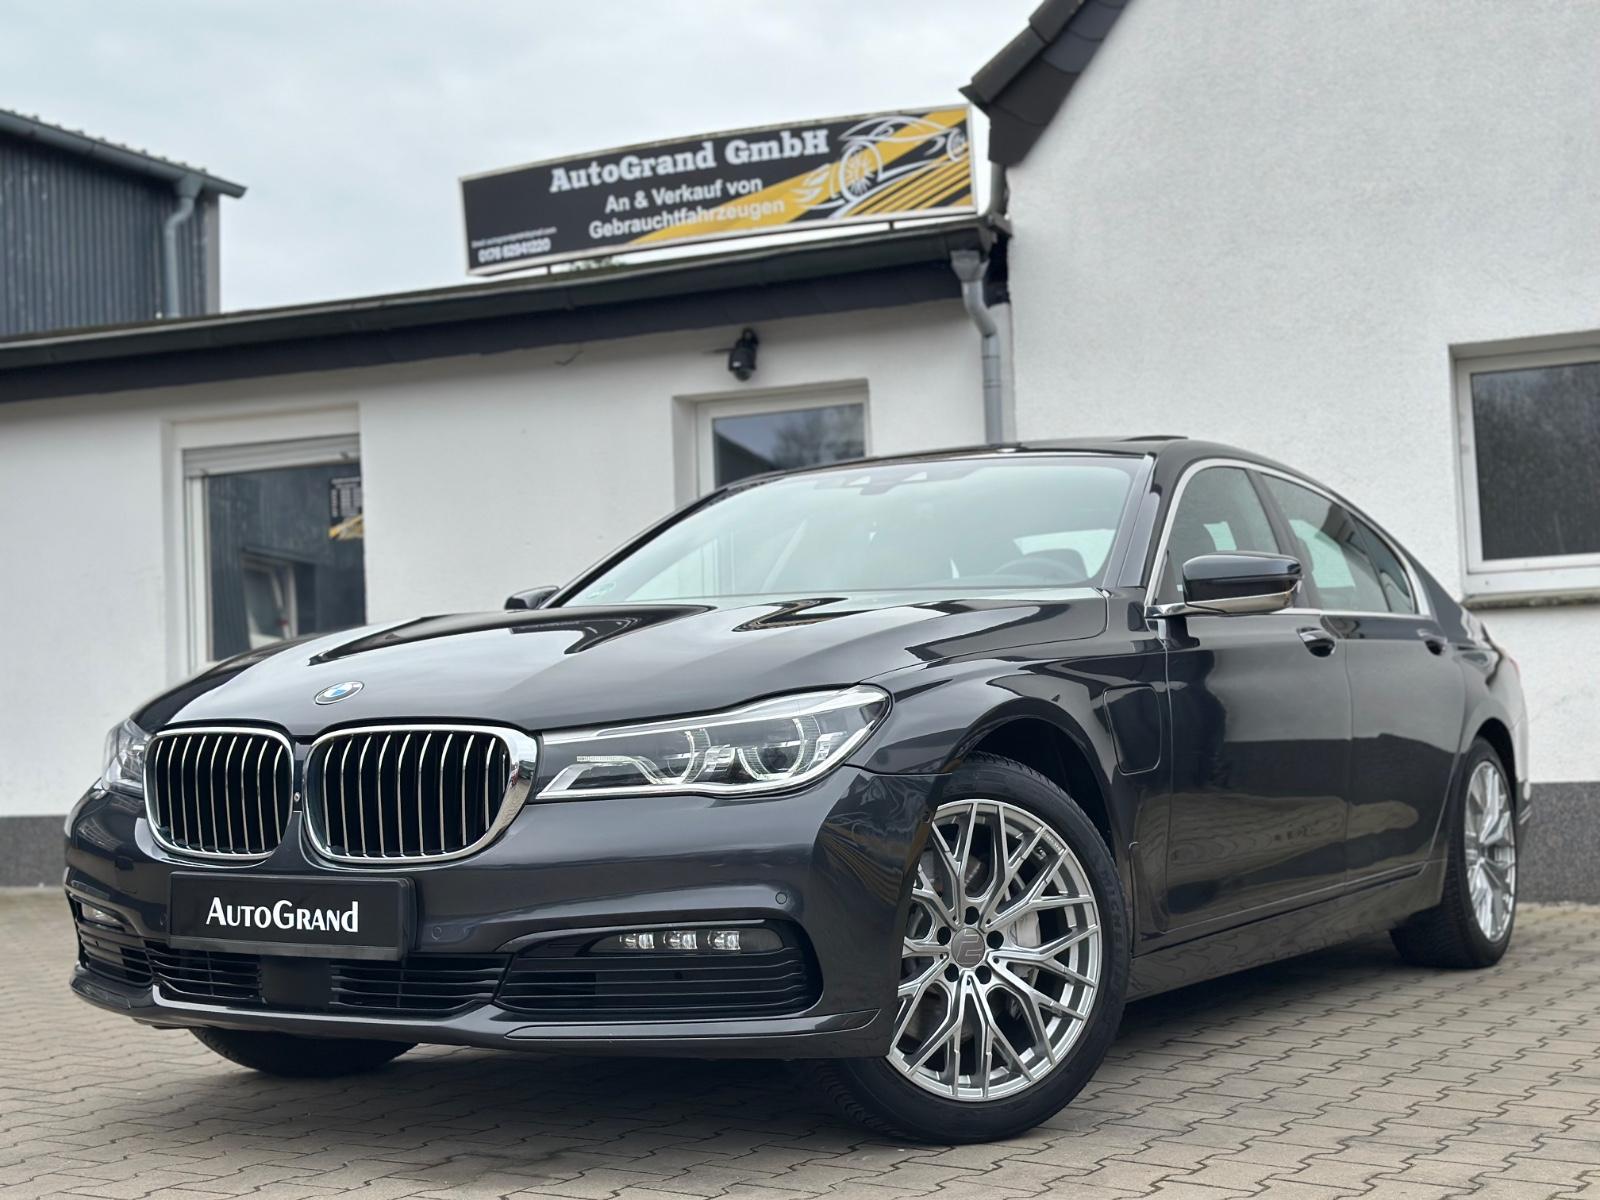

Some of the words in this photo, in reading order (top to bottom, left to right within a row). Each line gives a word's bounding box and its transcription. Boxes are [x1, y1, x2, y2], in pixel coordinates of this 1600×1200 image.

[549, 141, 717, 193] AutoGrand
[724, 128, 830, 165] GmbH
[605, 195, 630, 214] An
[634, 190, 651, 209] &
[651, 179, 723, 206] Verkauf
[726, 177, 762, 195] von
[588, 199, 785, 239] Gebrauchtfahrzeugen
